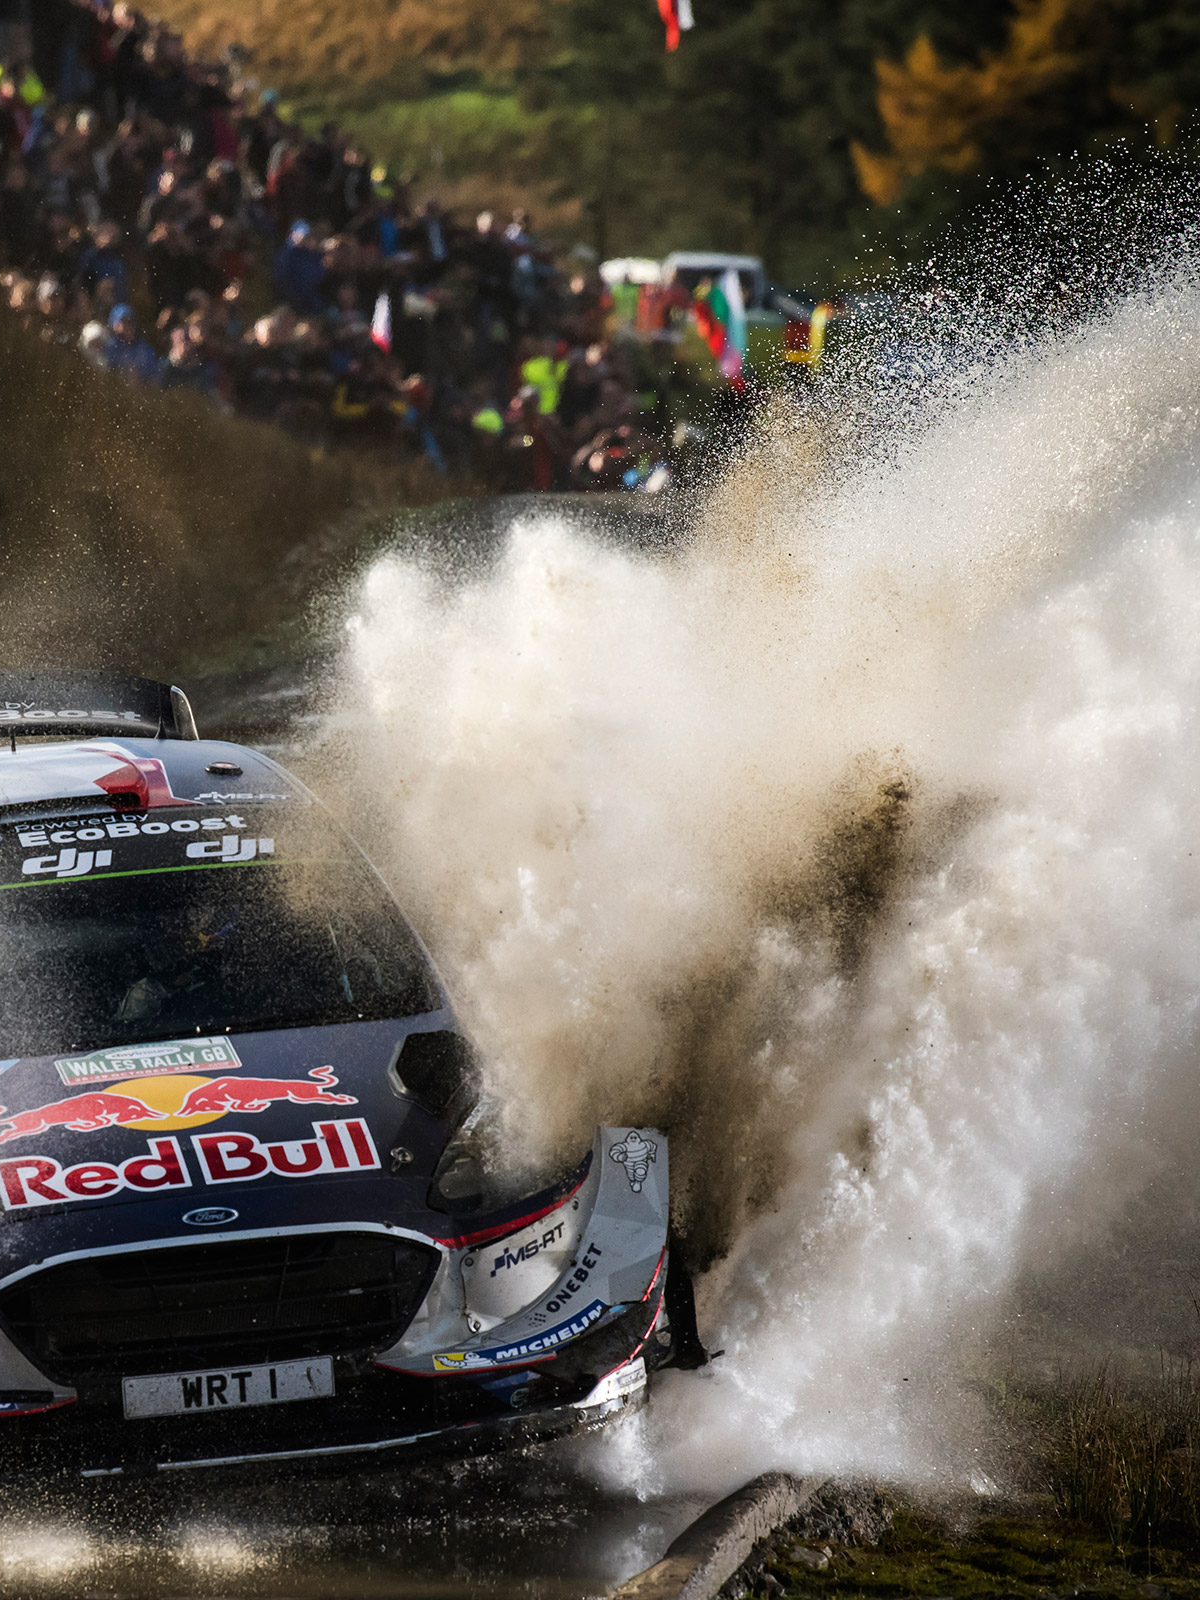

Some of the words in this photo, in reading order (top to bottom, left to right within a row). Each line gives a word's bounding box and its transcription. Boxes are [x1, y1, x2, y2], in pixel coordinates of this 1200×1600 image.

[5, 701, 36, 712] by
[14, 814, 126, 833] Powered
[128, 813, 150, 823] by
[17, 814, 248, 848] EcoBoost
[66, 1059, 137, 1077] WALES
[140, 1051, 196, 1068] RALLY
[201, 1046, 228, 1062] GB
[0, 1138, 185, 1206] Red
[199, 1121, 375, 1181] Bull
[195, 1210, 226, 1222] Ford
[506, 1221, 565, 1270] MS-RT
[546, 1242, 602, 1313] ONEBET
[496, 1304, 603, 1360] MICHELIN
[180, 1371, 253, 1409] WRT
